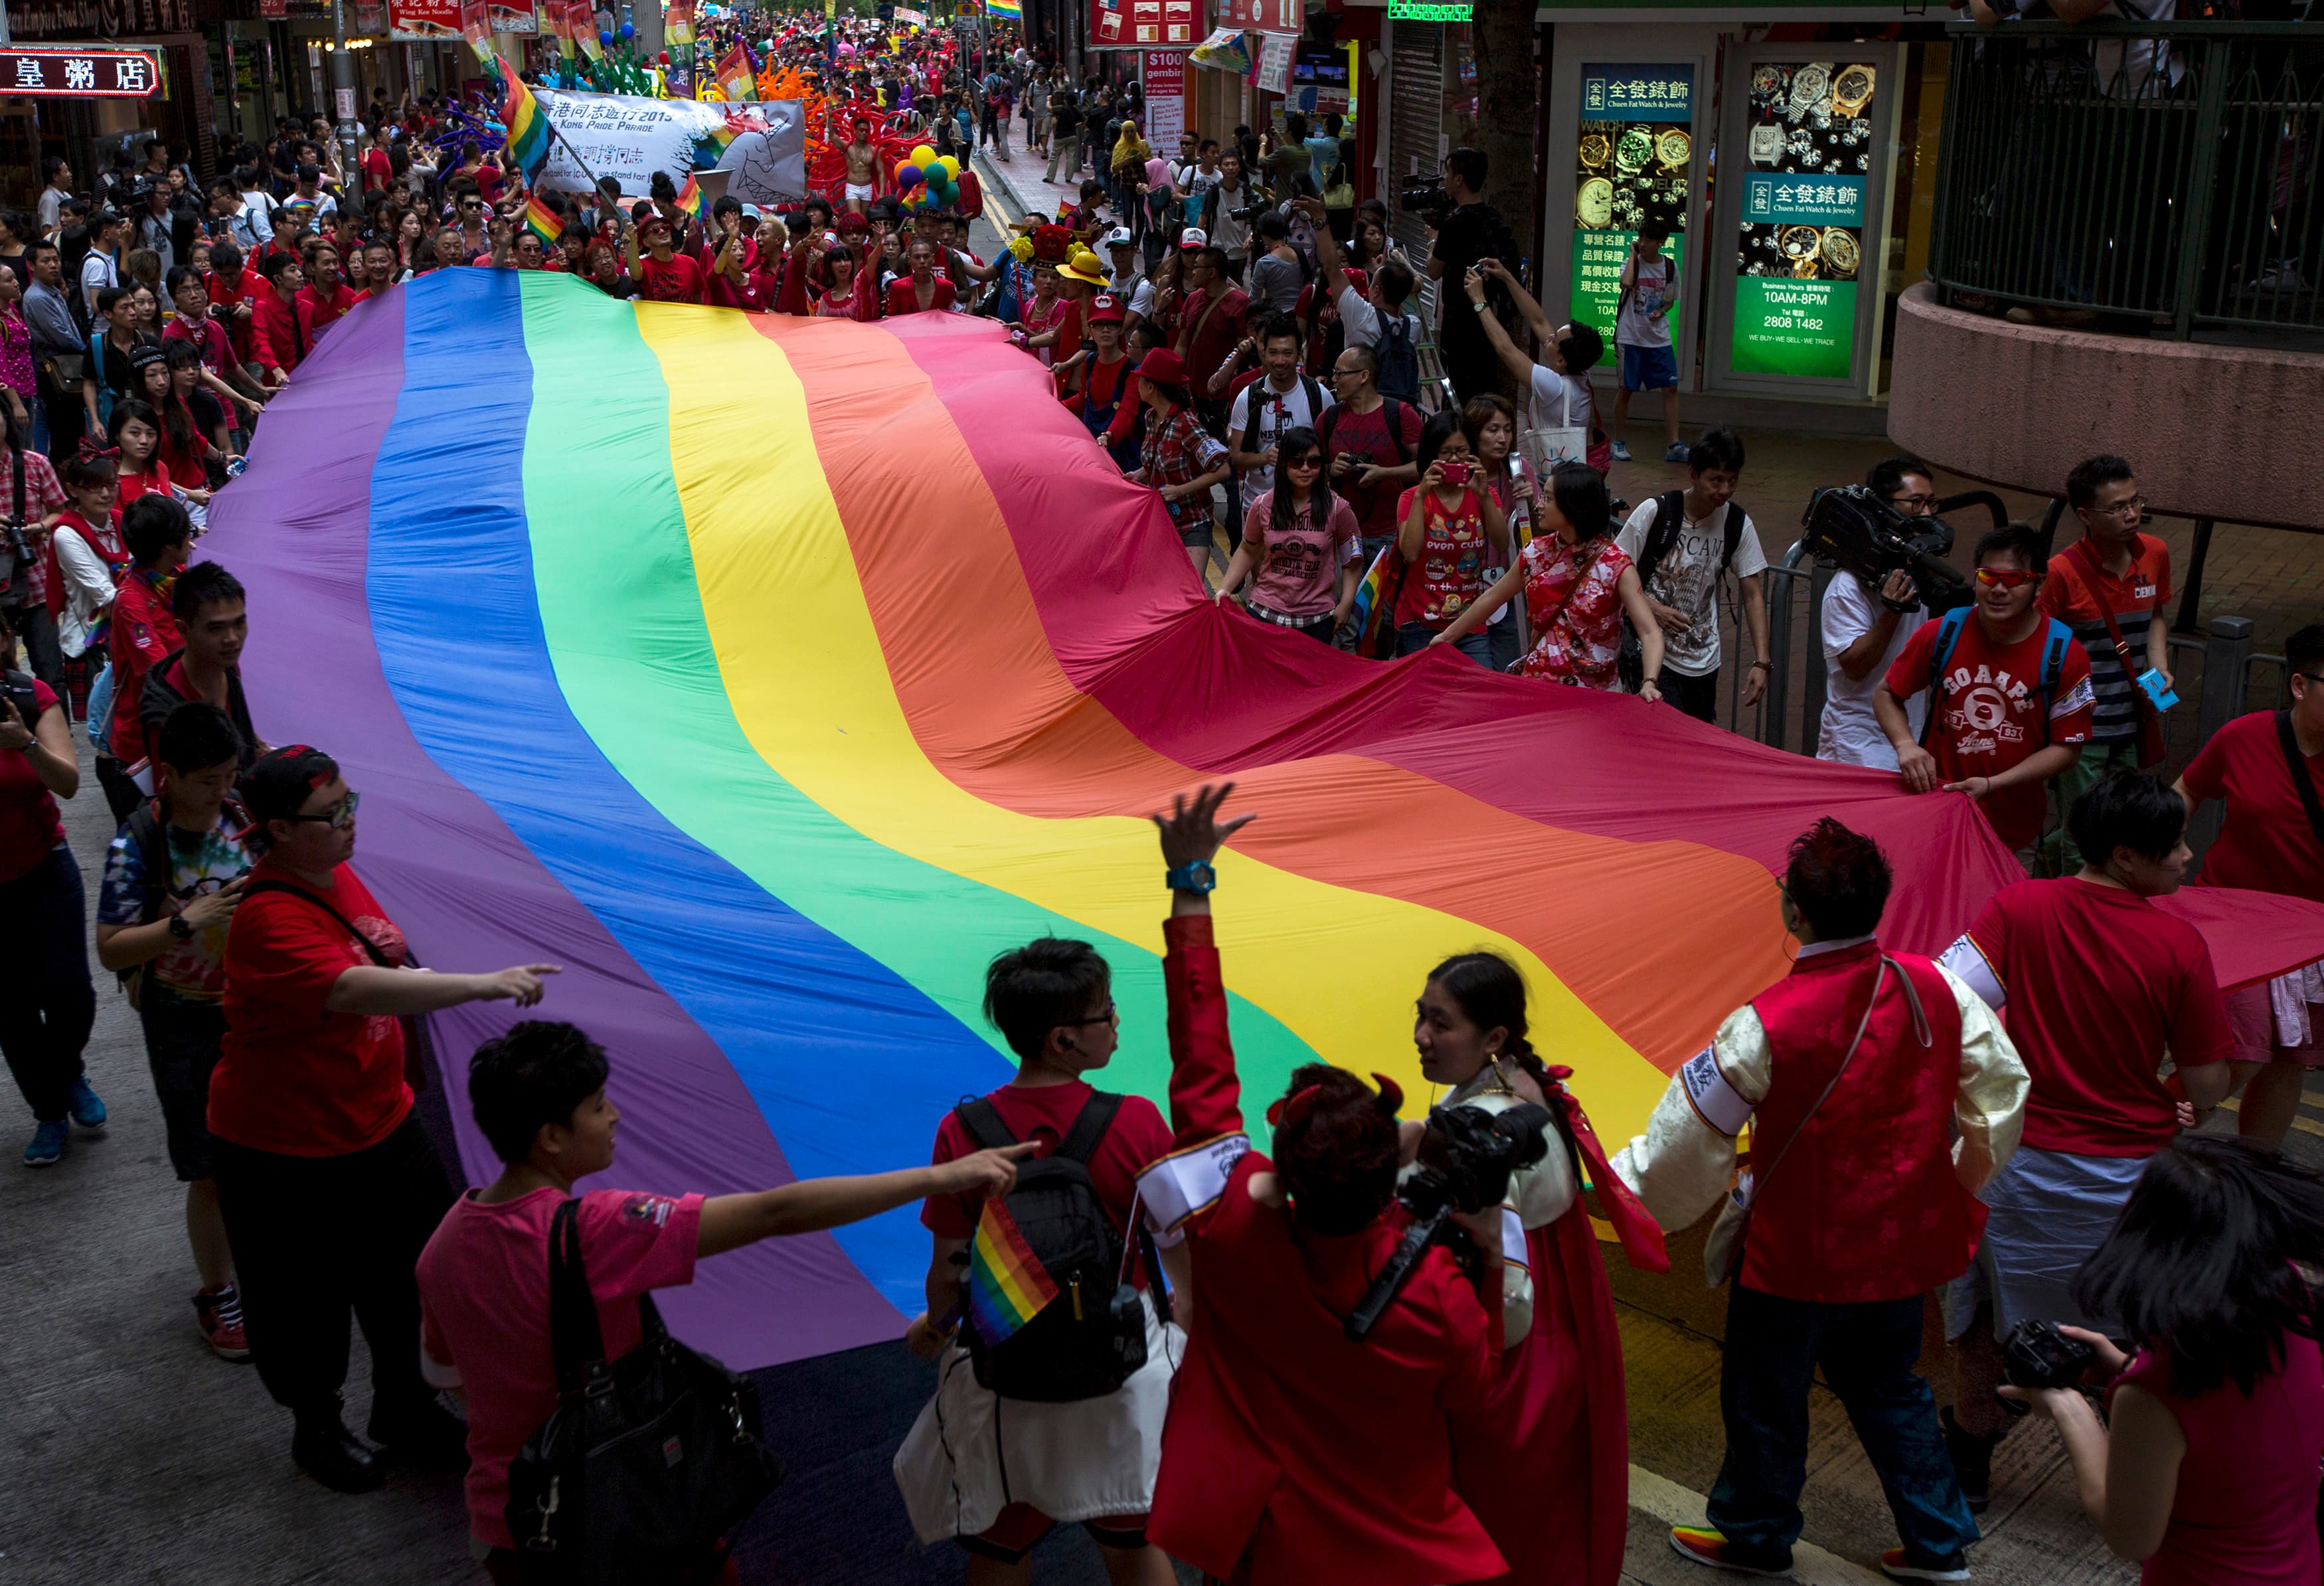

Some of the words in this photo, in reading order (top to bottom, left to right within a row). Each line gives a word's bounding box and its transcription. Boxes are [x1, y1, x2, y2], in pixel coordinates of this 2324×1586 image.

[1149, 53, 1183, 66] $100
[15, 57, 145, 90] 皇粥店
[1589, 82, 1602, 106] 全發
[1609, 80, 1689, 100] 全發錶飾
[1754, 185, 1767, 210] 全發
[1775, 183, 1858, 205] 全發錶飾
[1584, 234, 1625, 246] 專營名錶
[1582, 250, 1624, 262] 品質保證
[1580, 281, 1621, 293] 現金交易
[1764, 292, 1827, 306] 10AM-8PM
[1764, 316, 1792, 328] 2808
[1796, 318, 1823, 330] 1482
[1427, 541, 1455, 551] even
[1440, 582, 1459, 592] the
[2004, 727, 2017, 737] 93
